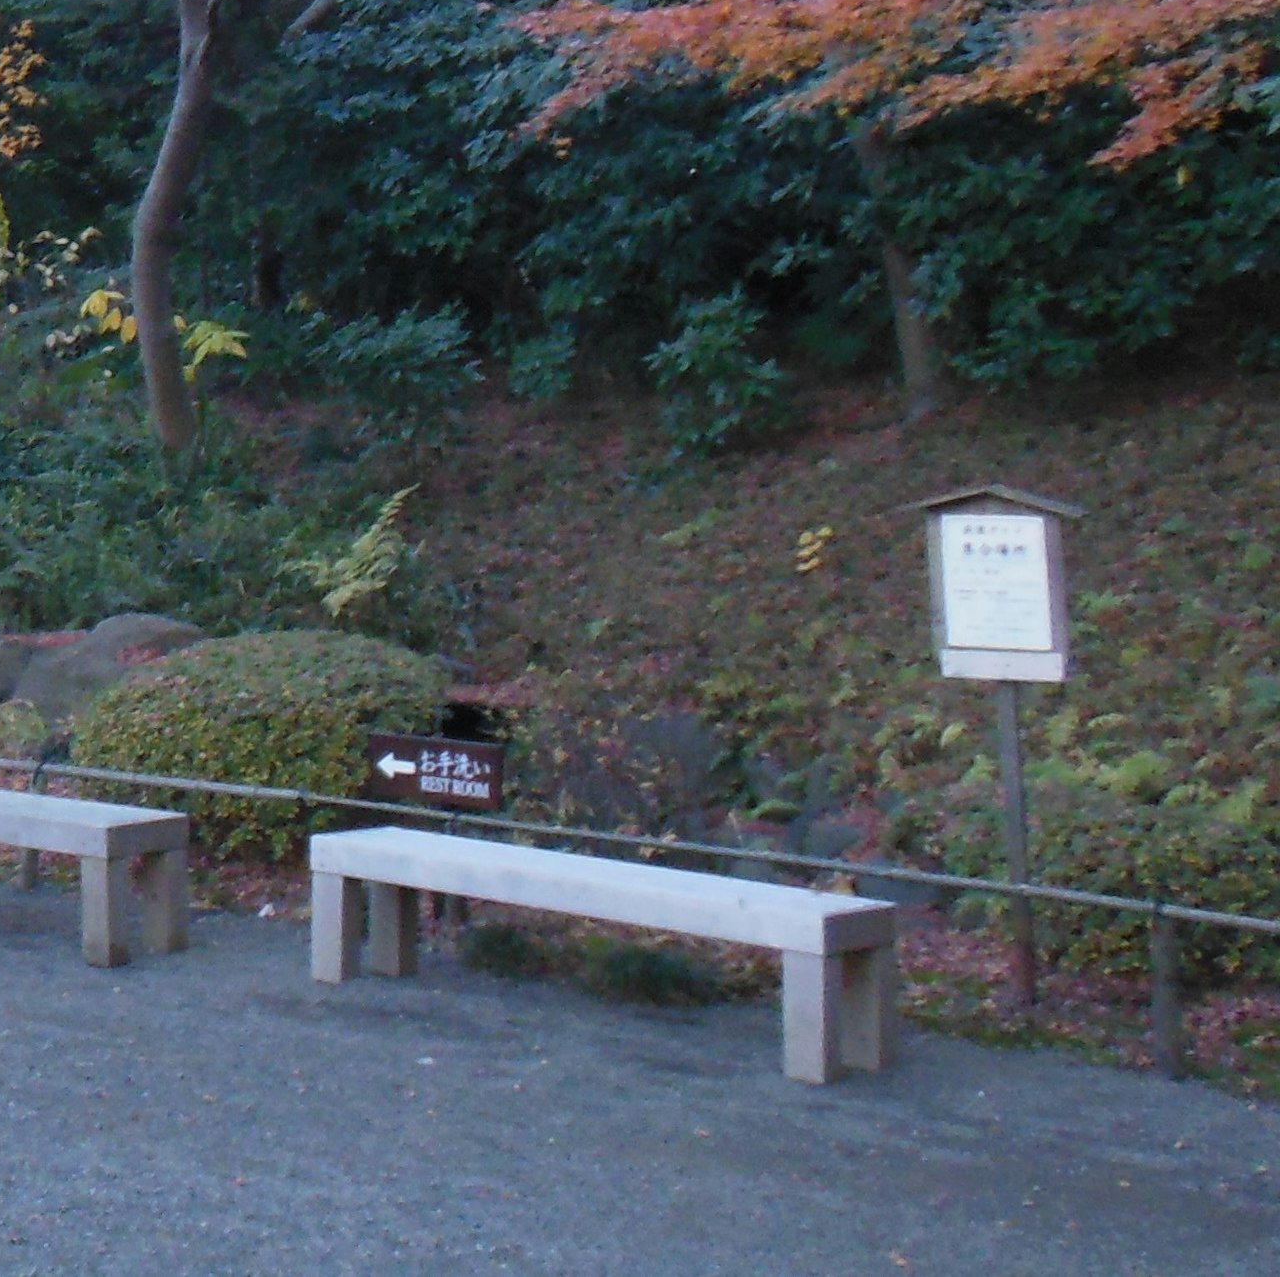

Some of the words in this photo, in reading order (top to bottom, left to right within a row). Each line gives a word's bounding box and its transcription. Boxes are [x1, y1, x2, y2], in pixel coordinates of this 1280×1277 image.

[421, 750, 490, 778] お手洗い
[421, 776, 449, 793] REST
[452, 779, 490, 798] ROOM
